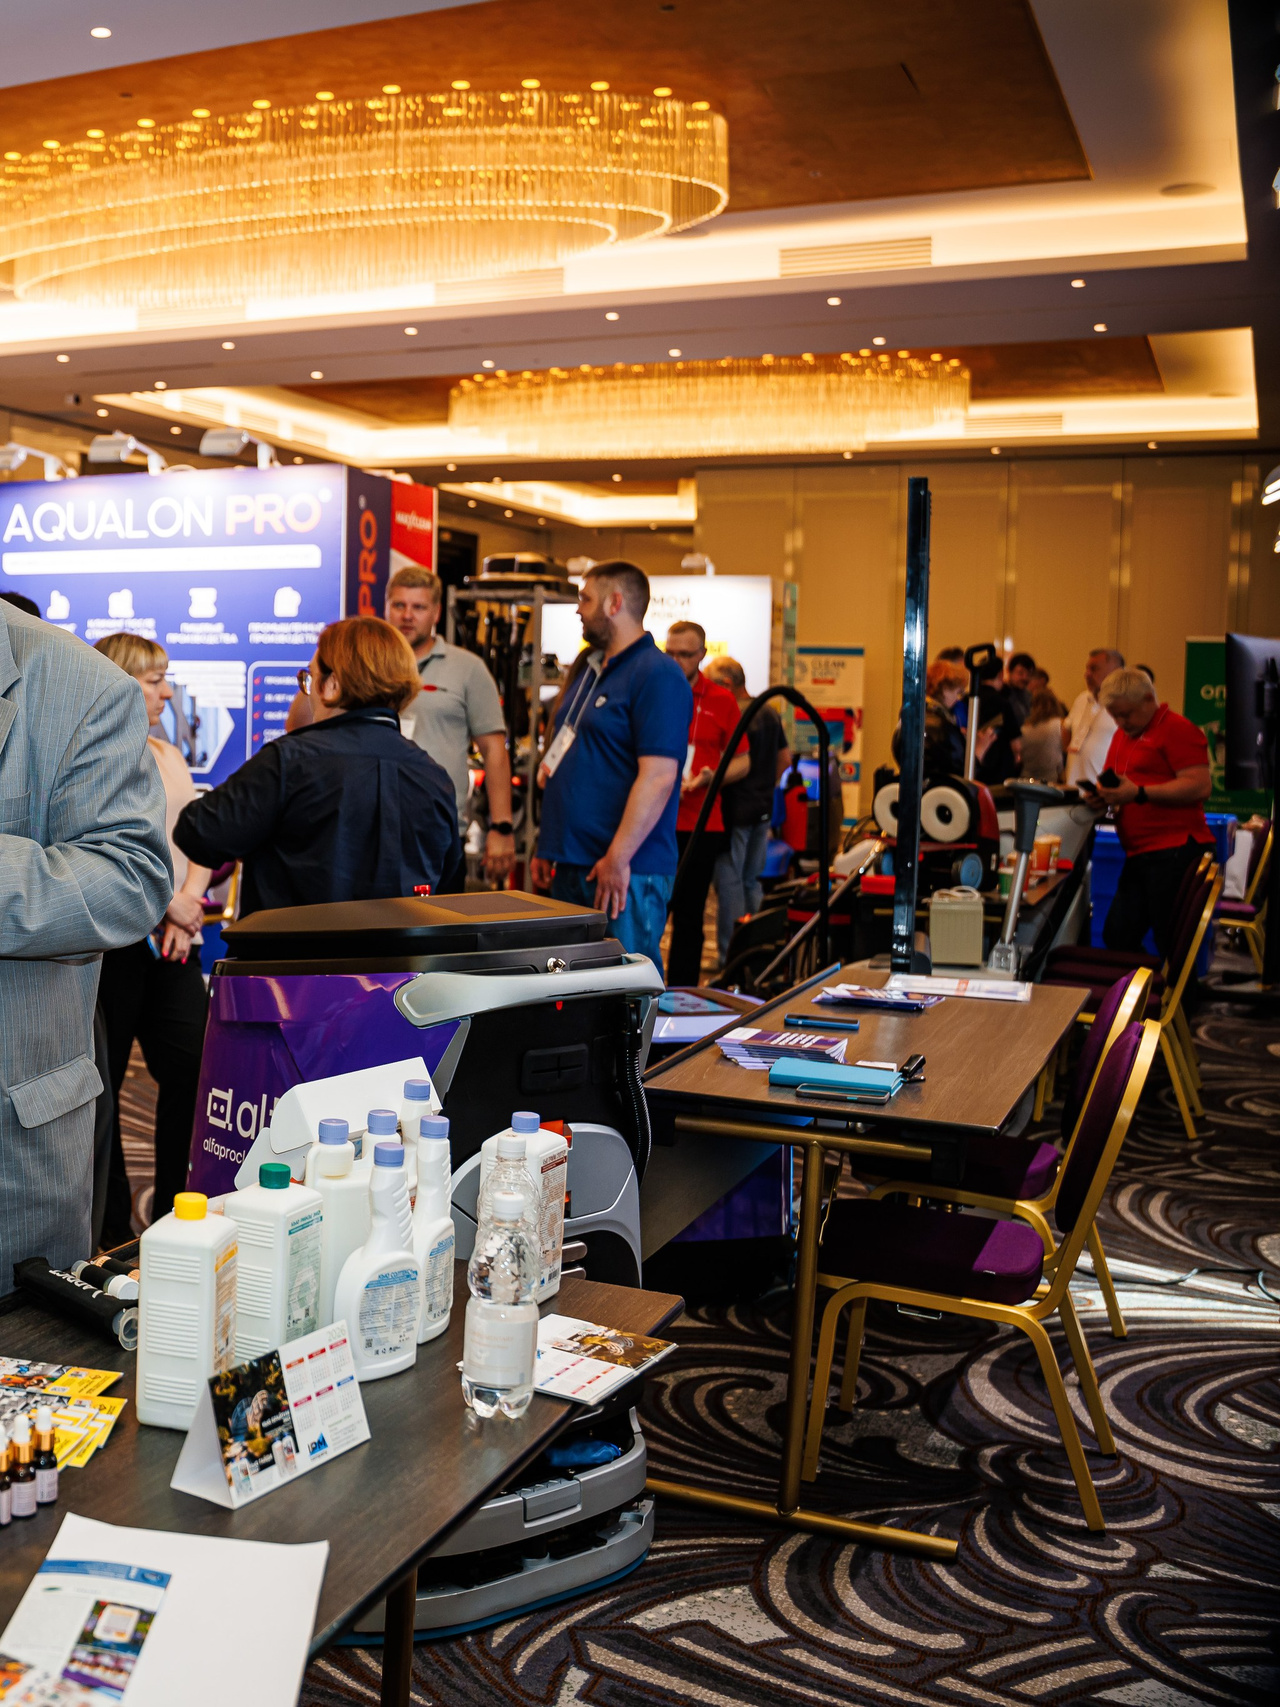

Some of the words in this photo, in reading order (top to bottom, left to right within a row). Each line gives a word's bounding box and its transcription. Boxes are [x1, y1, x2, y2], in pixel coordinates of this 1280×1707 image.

[2, 497, 214, 543] AQUALON
[225, 492, 321, 536] PRO
[357, 510, 378, 616] PRO
